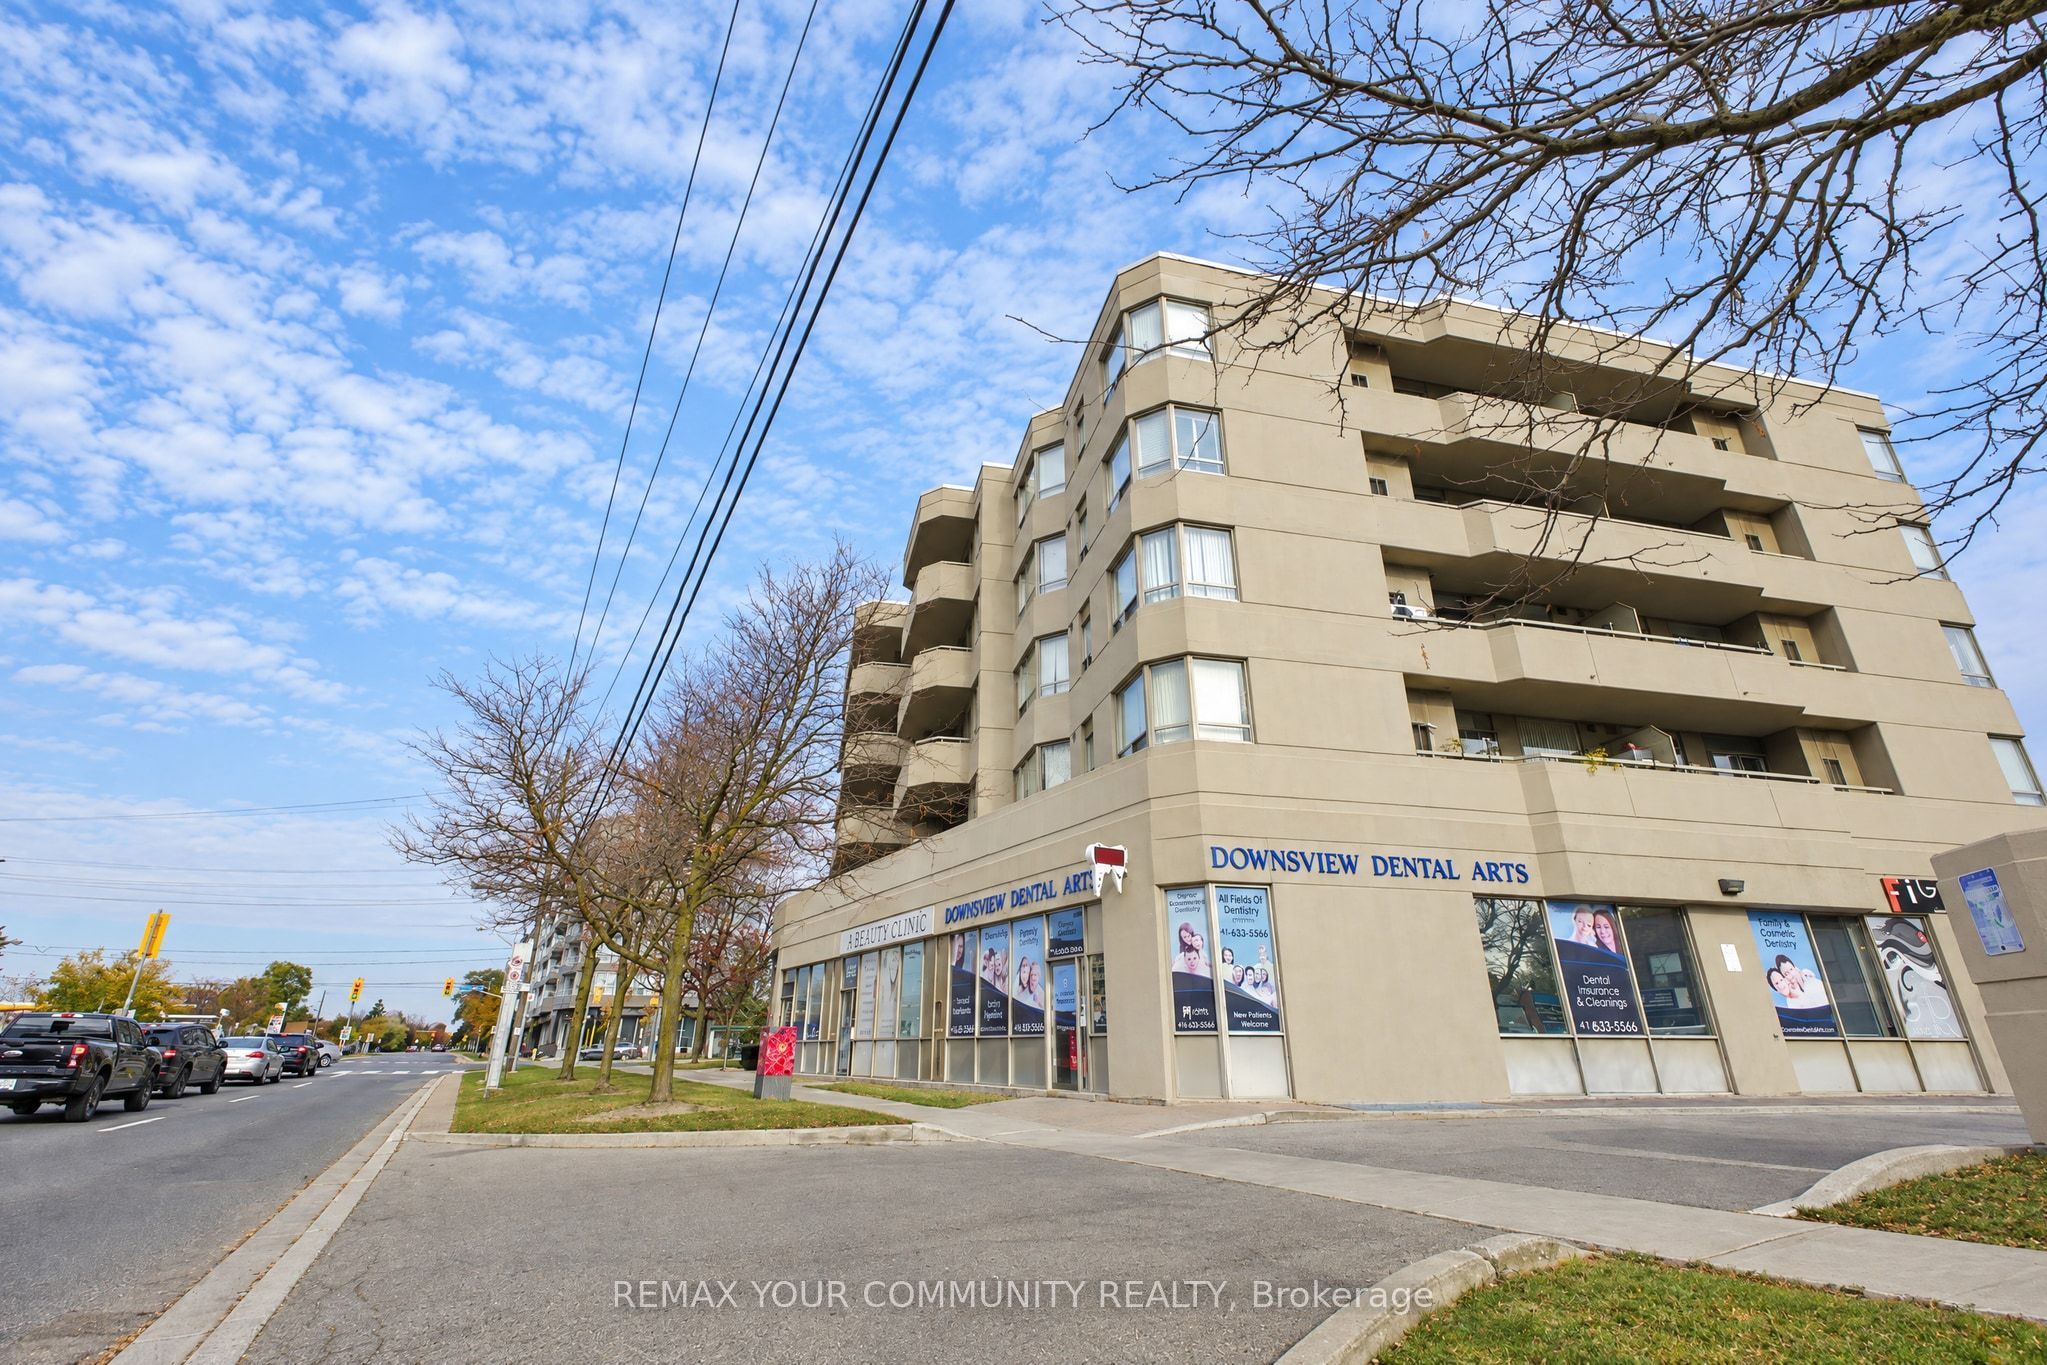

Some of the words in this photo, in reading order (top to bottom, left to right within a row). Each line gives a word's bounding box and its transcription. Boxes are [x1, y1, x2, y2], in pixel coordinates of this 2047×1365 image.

[1210, 846, 1359, 875] DOWNSVIEW
[1371, 855, 1461, 880] DENTAL
[1471, 861, 1530, 884] ARTS
[945, 893, 1006, 924] DOWNSVIEW
[1010, 880, 1057, 908] DENTAL
[1219, 894, 1228, 904] All
[1230, 894, 1251, 904] Fields
[1253, 895, 1263, 904] Of
[1224, 905, 1259, 917] Dentistry
[1758, 918, 1782, 928] Family
[854, 924, 889, 948] BEAUTY
[891, 912, 927, 938] CLINIC
[1760, 928, 1796, 938] Cosmetic
[1583, 975, 1610, 985] Dental
[1577, 985, 1620, 996] Insurance
[1576, 996, 1584, 1007] &
[1585, 997, 1628, 1010] Cleanings
[1248, 1011, 1272, 1019] Patients
[1241, 1020, 1269, 1028] Welcome
